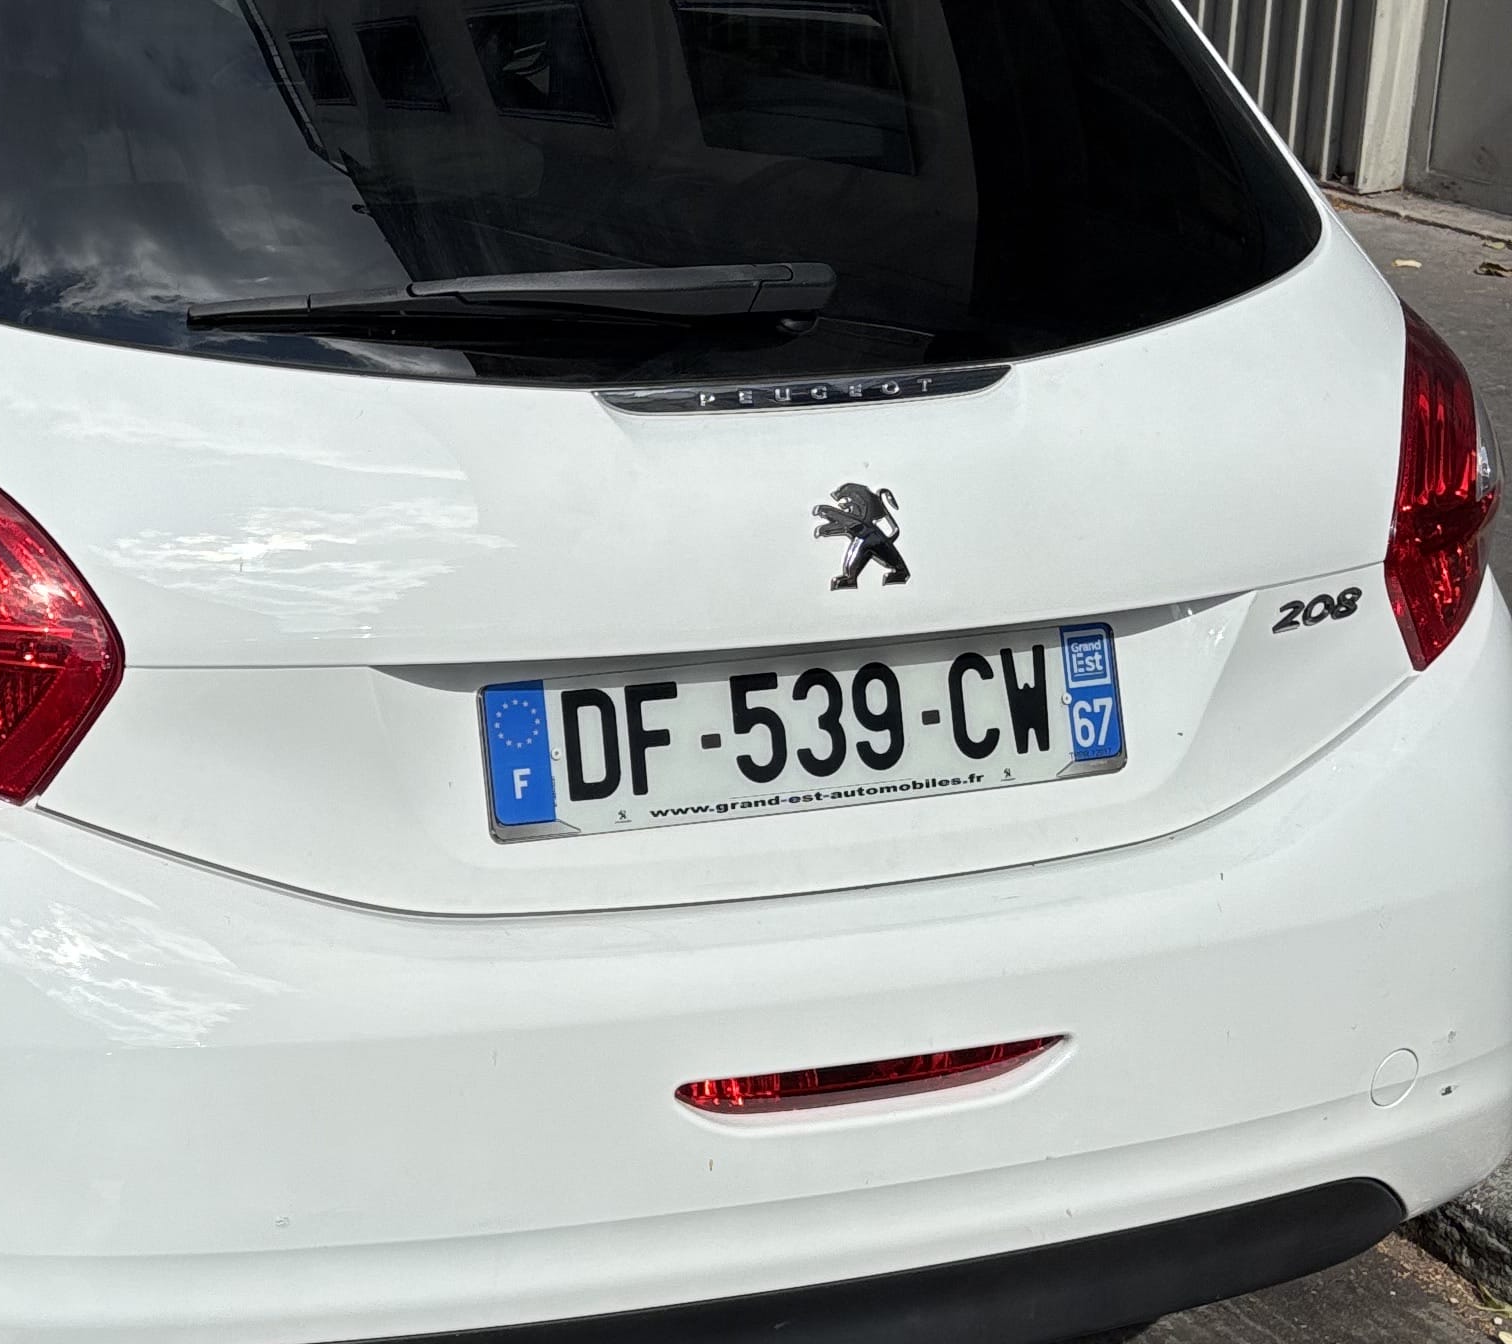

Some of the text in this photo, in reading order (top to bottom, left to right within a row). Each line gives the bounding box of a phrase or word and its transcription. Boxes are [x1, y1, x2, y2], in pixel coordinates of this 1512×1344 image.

[699, 377, 933, 407] PEUGEOT
[1271, 586, 1363, 634] 208
[1070, 639, 1102, 654] Grand
[1072, 651, 1104, 674] Est
[560, 643, 1050, 802] DF-539-CW
[1072, 696, 1113, 748] 67
[512, 768, 532, 800] F
[648, 772, 985, 818] www.grand-est-automobiles.fr
